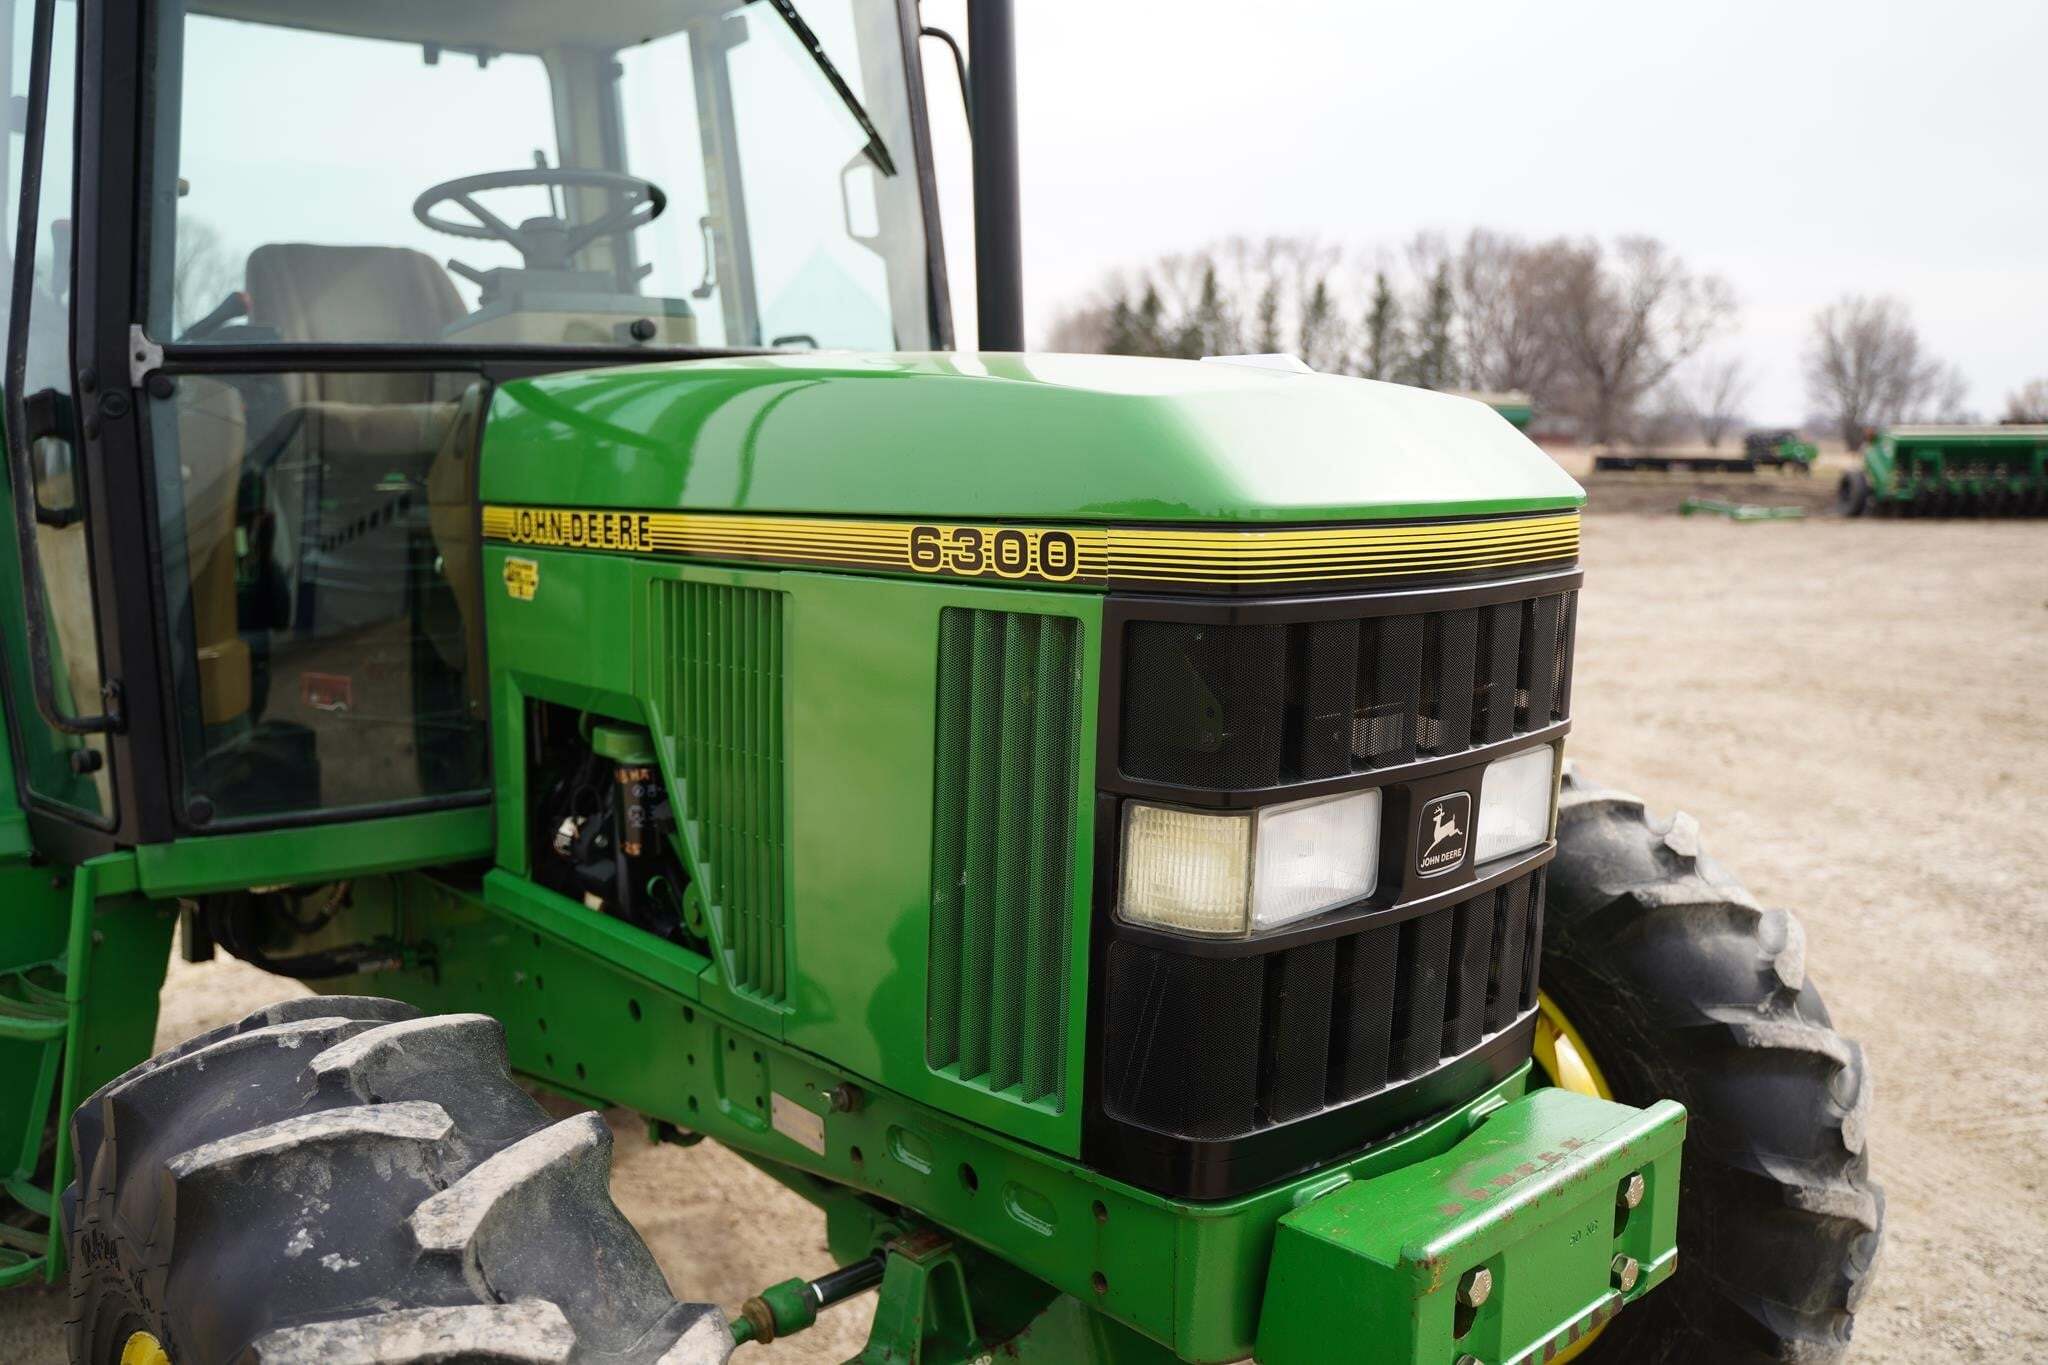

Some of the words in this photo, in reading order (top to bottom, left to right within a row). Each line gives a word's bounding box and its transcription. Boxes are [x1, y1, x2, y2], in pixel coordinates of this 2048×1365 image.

[510, 510, 563, 543] JOHN
[570, 513, 652, 549] DEERE
[909, 525, 1078, 579] 6300
[1420, 855, 1441, 868] JOHN
[1441, 848, 1462, 862] DEERE
